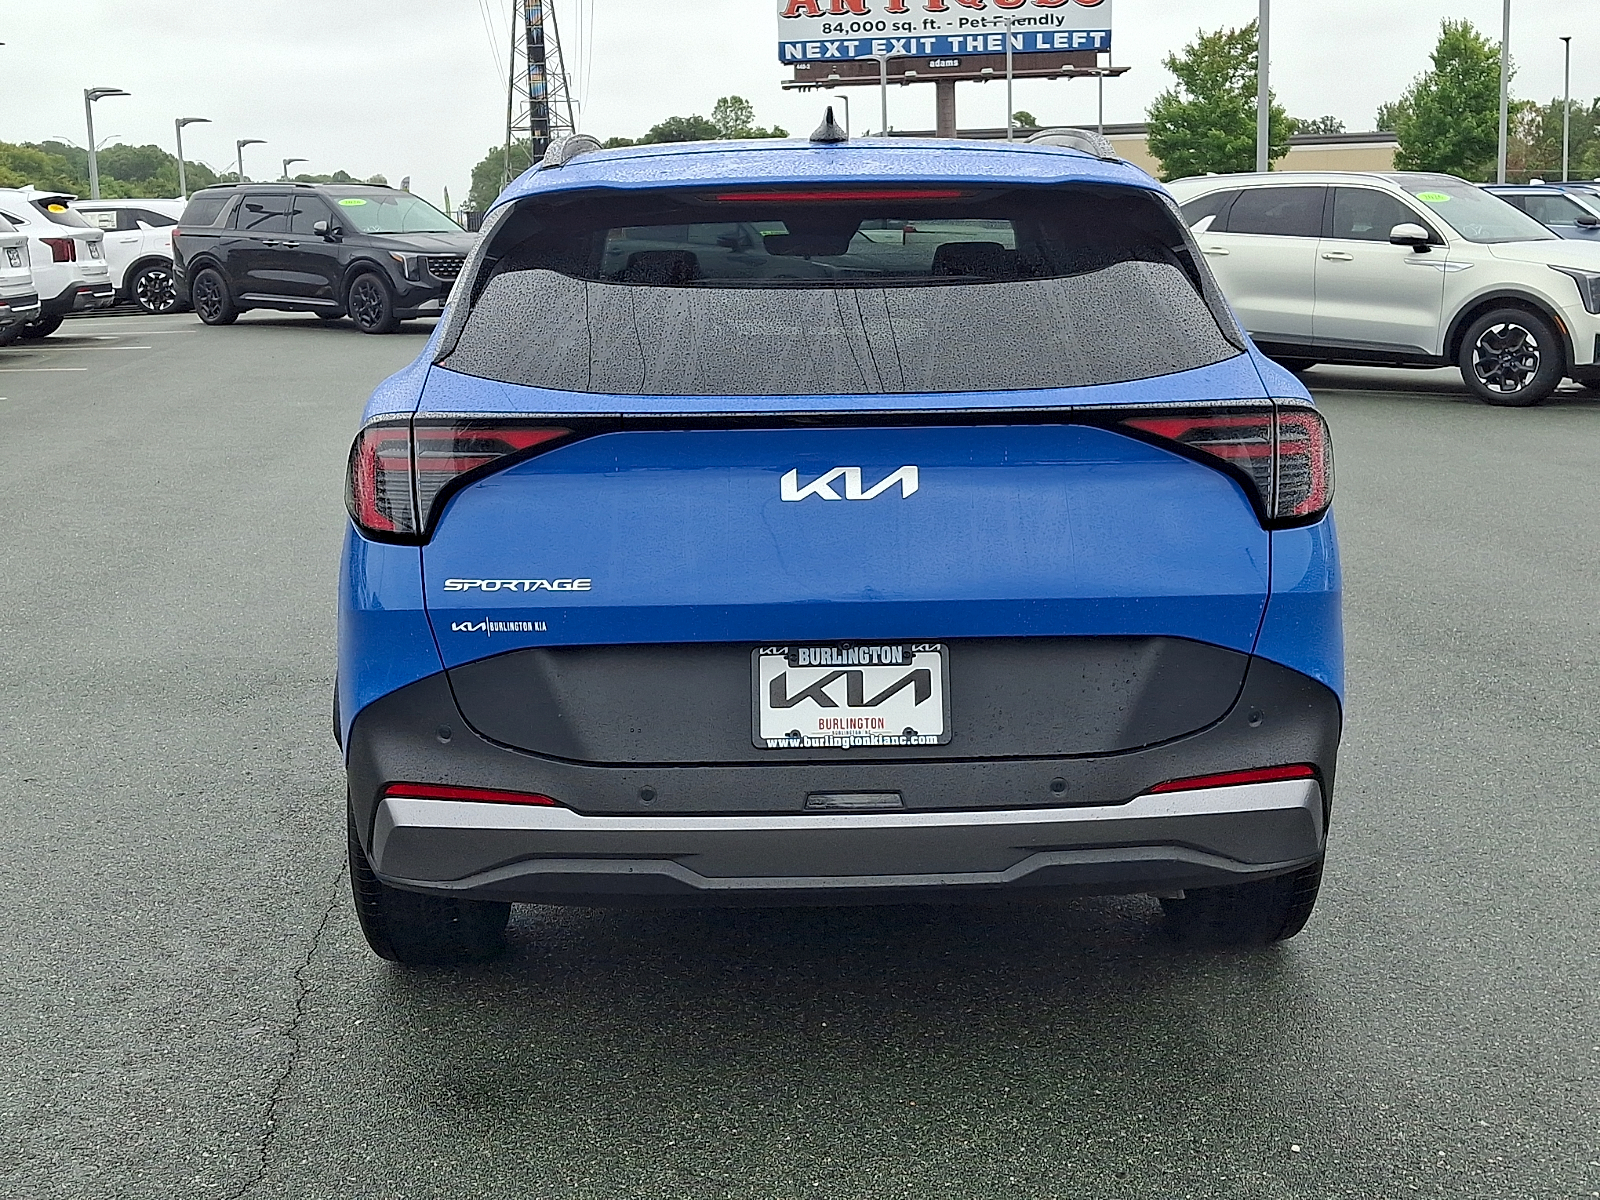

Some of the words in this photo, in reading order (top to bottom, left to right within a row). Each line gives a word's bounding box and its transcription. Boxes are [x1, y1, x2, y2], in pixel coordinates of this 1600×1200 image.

[822, 21, 886, 35] 84,000
[892, 21, 917, 33] sq.
[922, 18, 941, 30] ft.
[959, 16, 987, 28] Pet
[784, 40, 860, 60] NEXT
[872, 37, 936, 55] EXIT
[947, 34, 1023, 53] THEN
[1036, 32, 1106, 49] LEFT
[929, 58, 960, 68] adams
[780, 465, 919, 501] KIA
[443, 578, 592, 592] SPORTAGE
[490, 621, 533, 632] BURLINGTON
[535, 621, 547, 631] KIA
[798, 646, 903, 665] BURLINGTON
[769, 669, 931, 709] KIA
[818, 717, 885, 730] BURLINGTON
[767, 735, 938, 749] www.burlingtonkianc.com
